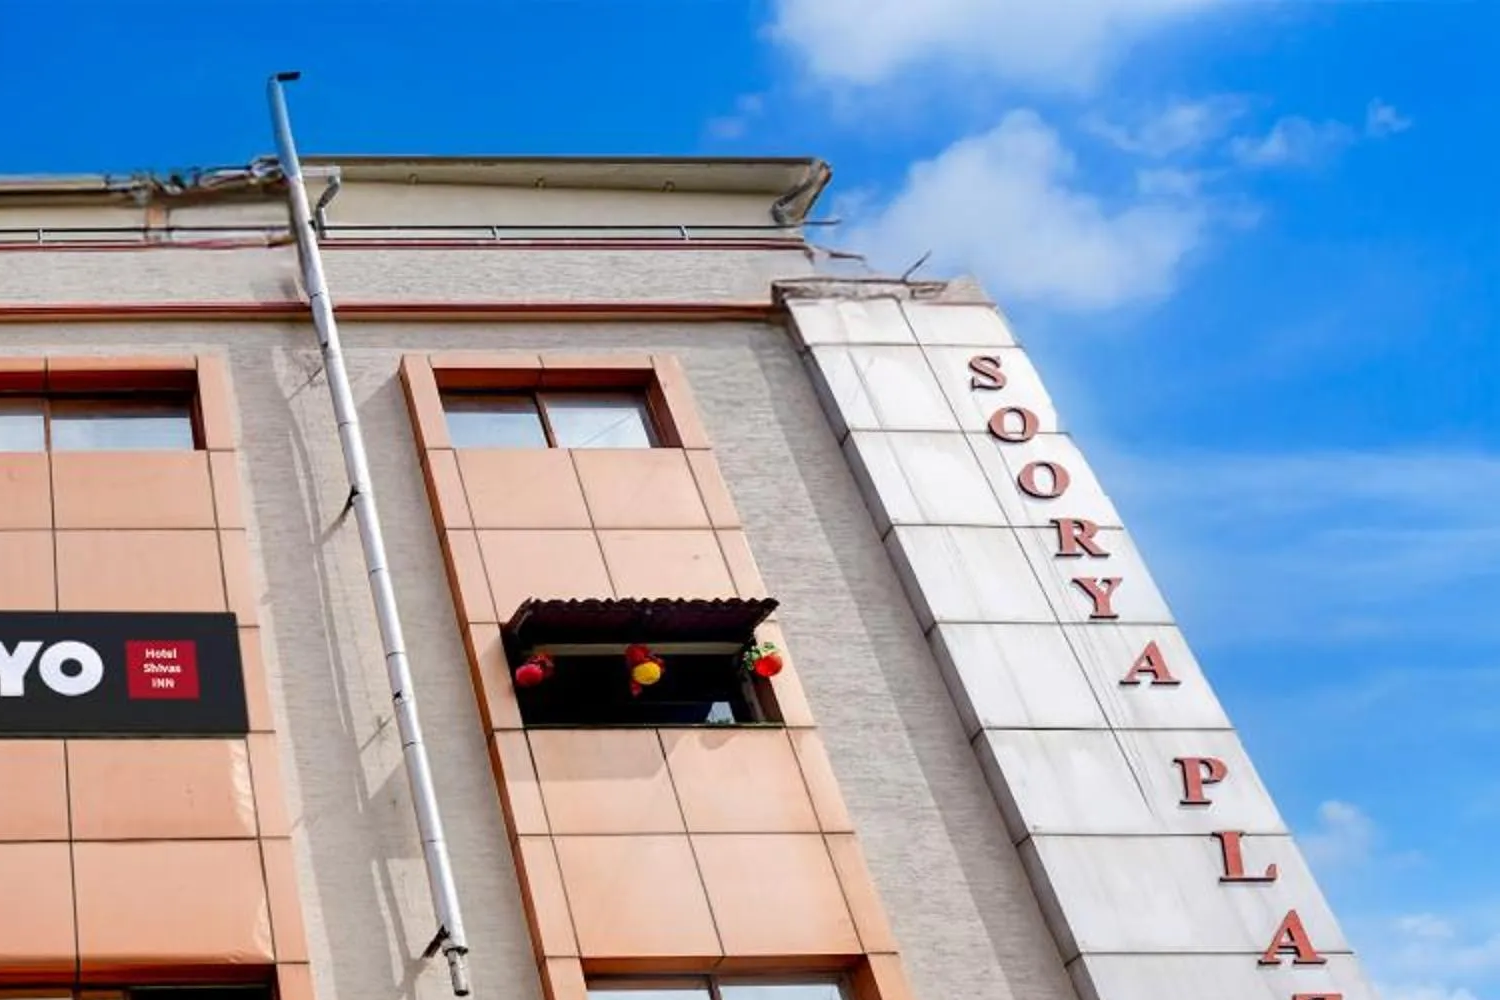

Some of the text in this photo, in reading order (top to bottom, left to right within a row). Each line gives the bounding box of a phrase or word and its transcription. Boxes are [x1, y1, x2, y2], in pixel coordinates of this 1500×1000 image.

[968, 354, 1181, 685] SOORYA
[145, 648, 177, 659] Hotel
[143, 663, 181, 673] Shivas
